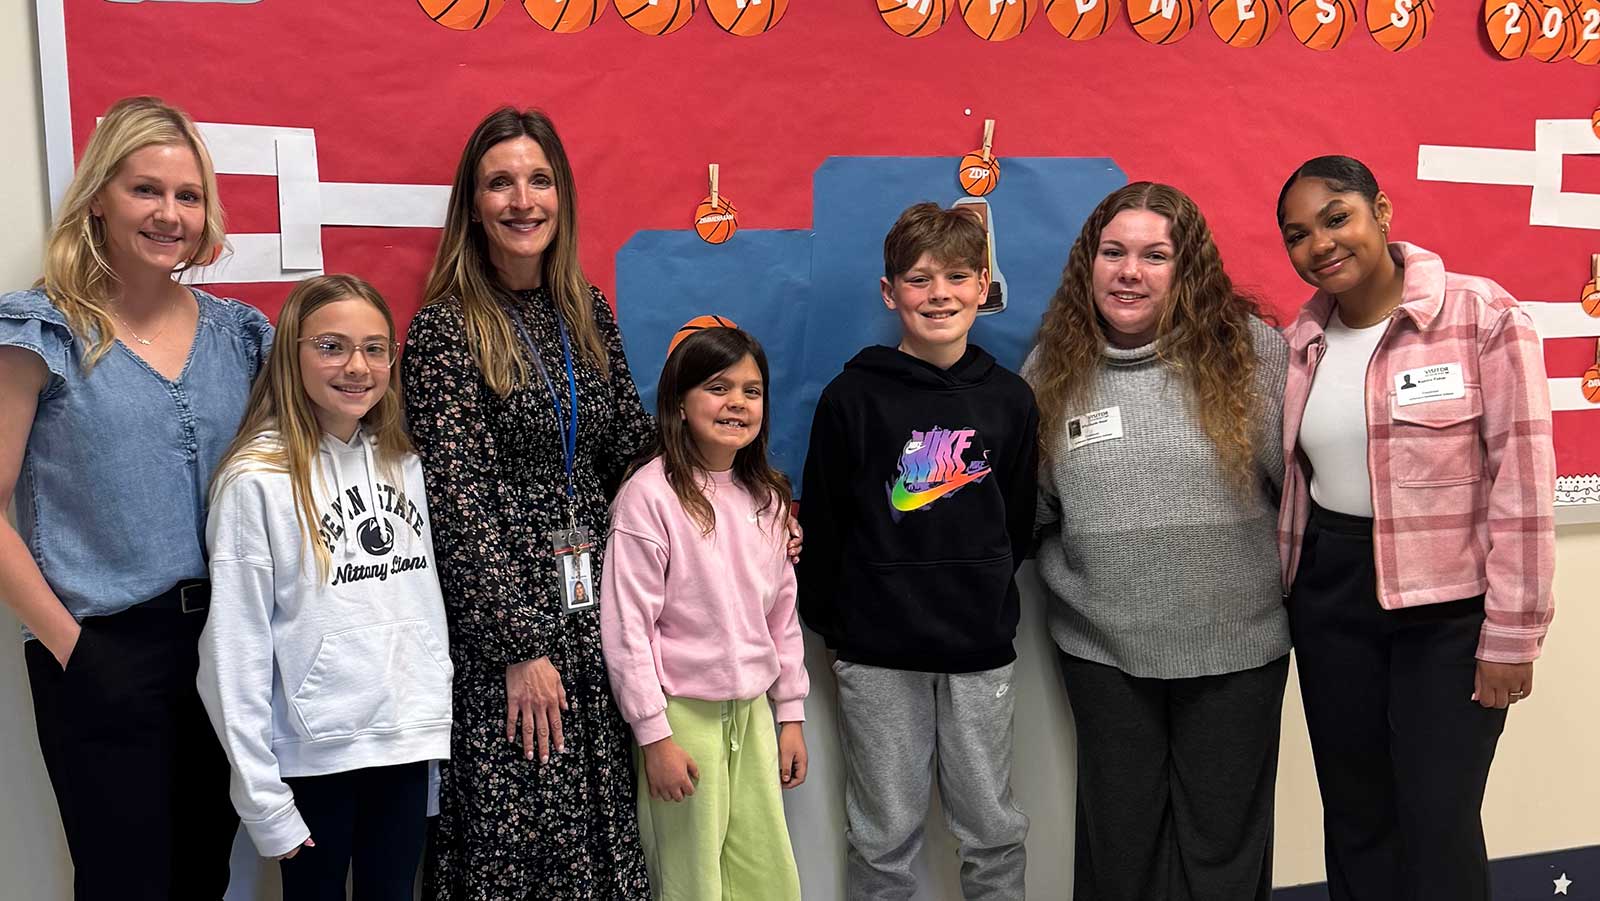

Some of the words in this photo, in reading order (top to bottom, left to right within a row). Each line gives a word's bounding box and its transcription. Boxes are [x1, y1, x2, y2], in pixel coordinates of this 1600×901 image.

[968, 168, 990, 180] ZDP
[698, 213, 734, 224] ZIMMERMAN
[1424, 366, 1448, 374] VISITOR
[331, 563, 388, 586] Nittany
[391, 555, 427, 575] Lions
